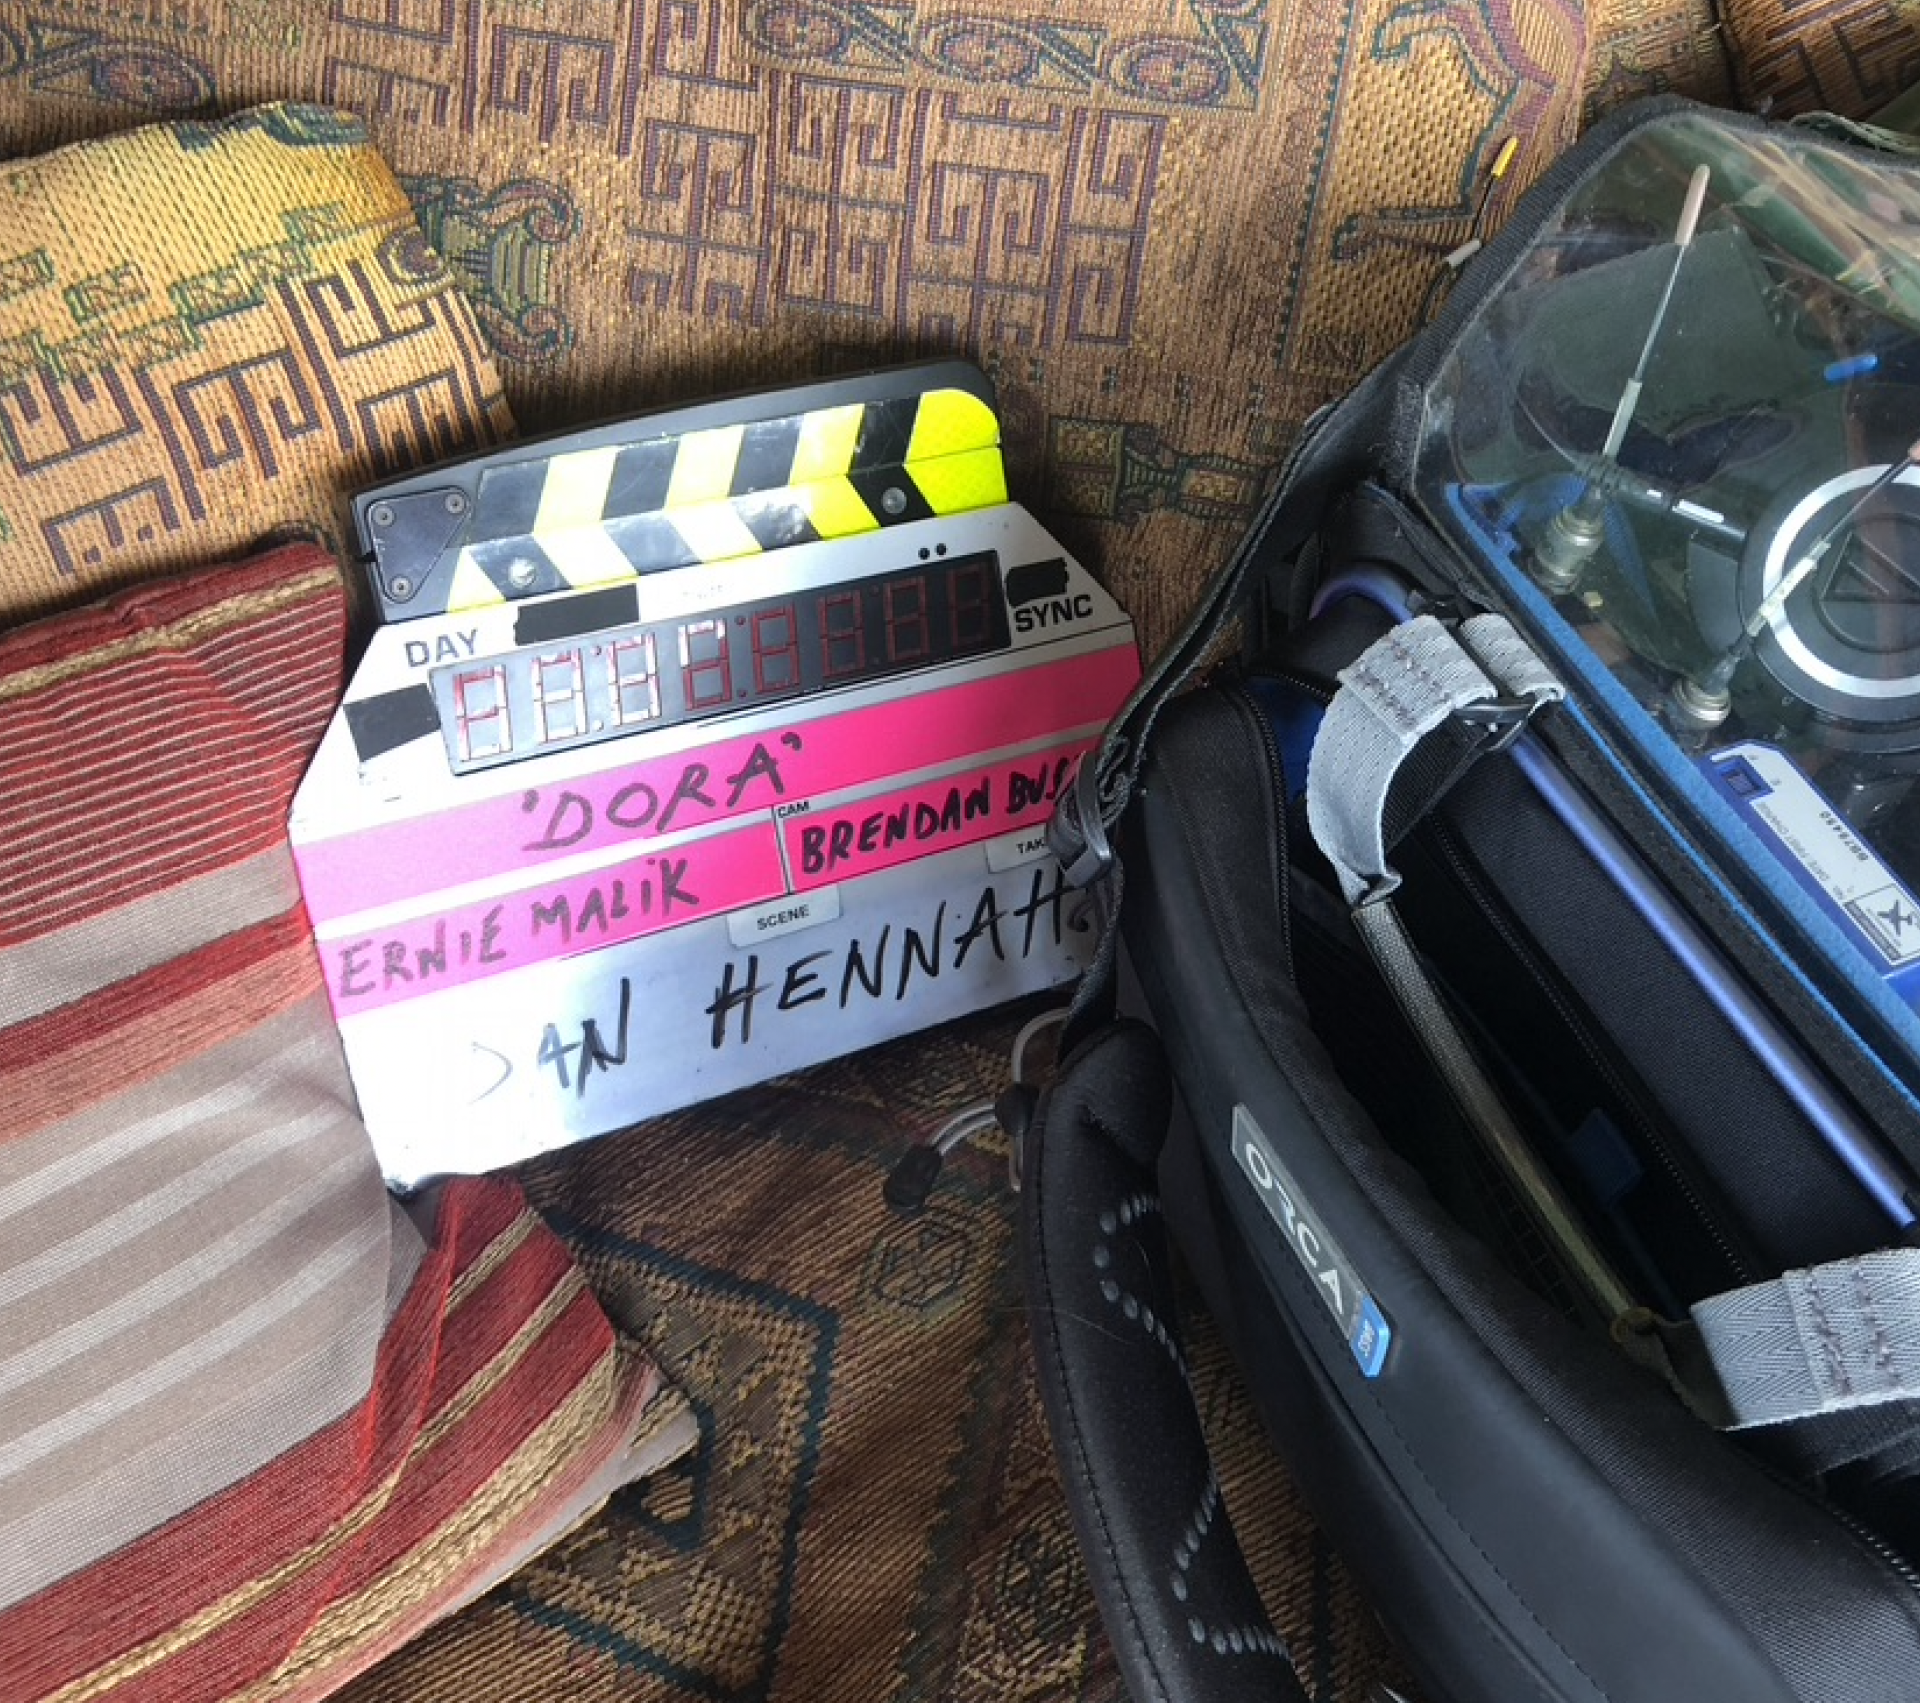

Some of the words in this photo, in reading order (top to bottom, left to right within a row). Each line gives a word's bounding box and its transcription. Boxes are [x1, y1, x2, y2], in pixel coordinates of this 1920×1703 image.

[1015, 593, 1093, 632] SYNC
[404, 628, 478, 667] DAY
[777, 801, 810, 818] CAM
[801, 776, 990, 874] BRENDAN
[1006, 757, 1074, 814] BUS
[1016, 837, 1047, 855] TAK
[756, 904, 810, 931] SCENE
[339, 903, 507, 998] ERNIE
[706, 865, 1080, 1050] HENNAH
[1246, 1143, 1344, 1315] ORCA
